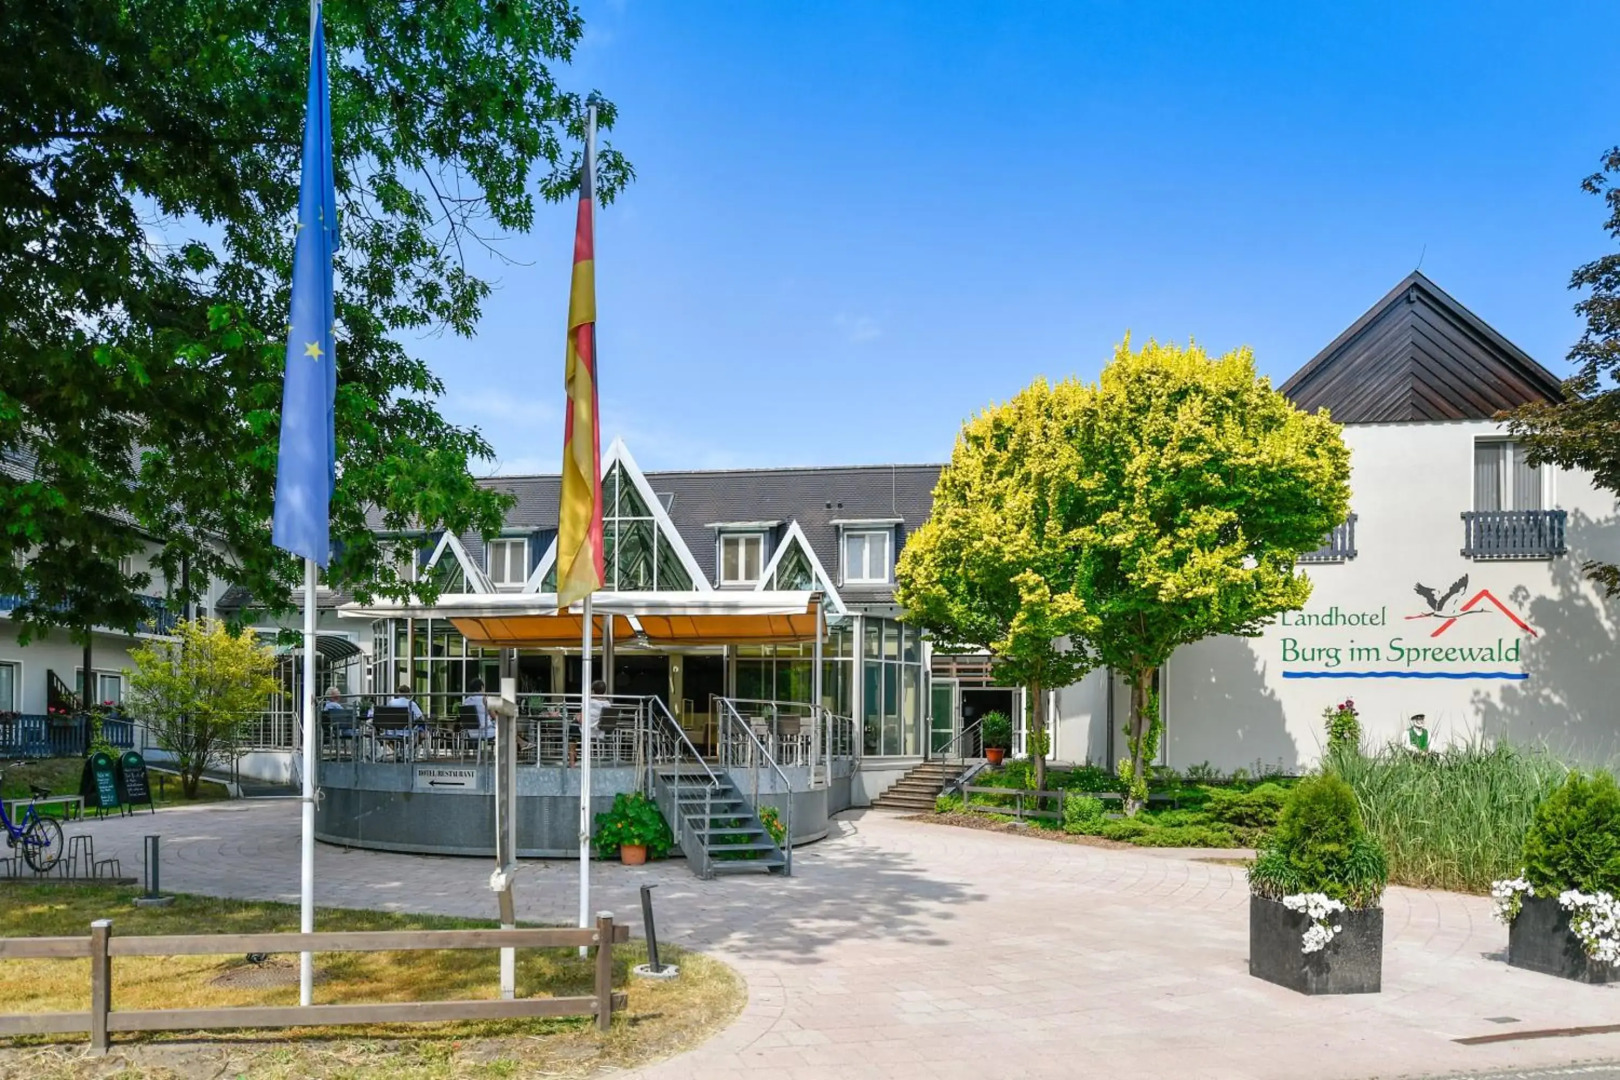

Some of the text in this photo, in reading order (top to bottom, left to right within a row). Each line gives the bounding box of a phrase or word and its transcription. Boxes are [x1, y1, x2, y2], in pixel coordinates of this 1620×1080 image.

[1281, 606, 1386, 626] Landhotel
[1280, 638, 1521, 667] Burg im Spreewald
[418, 769, 474, 778] HOTEL RESTAURANT
